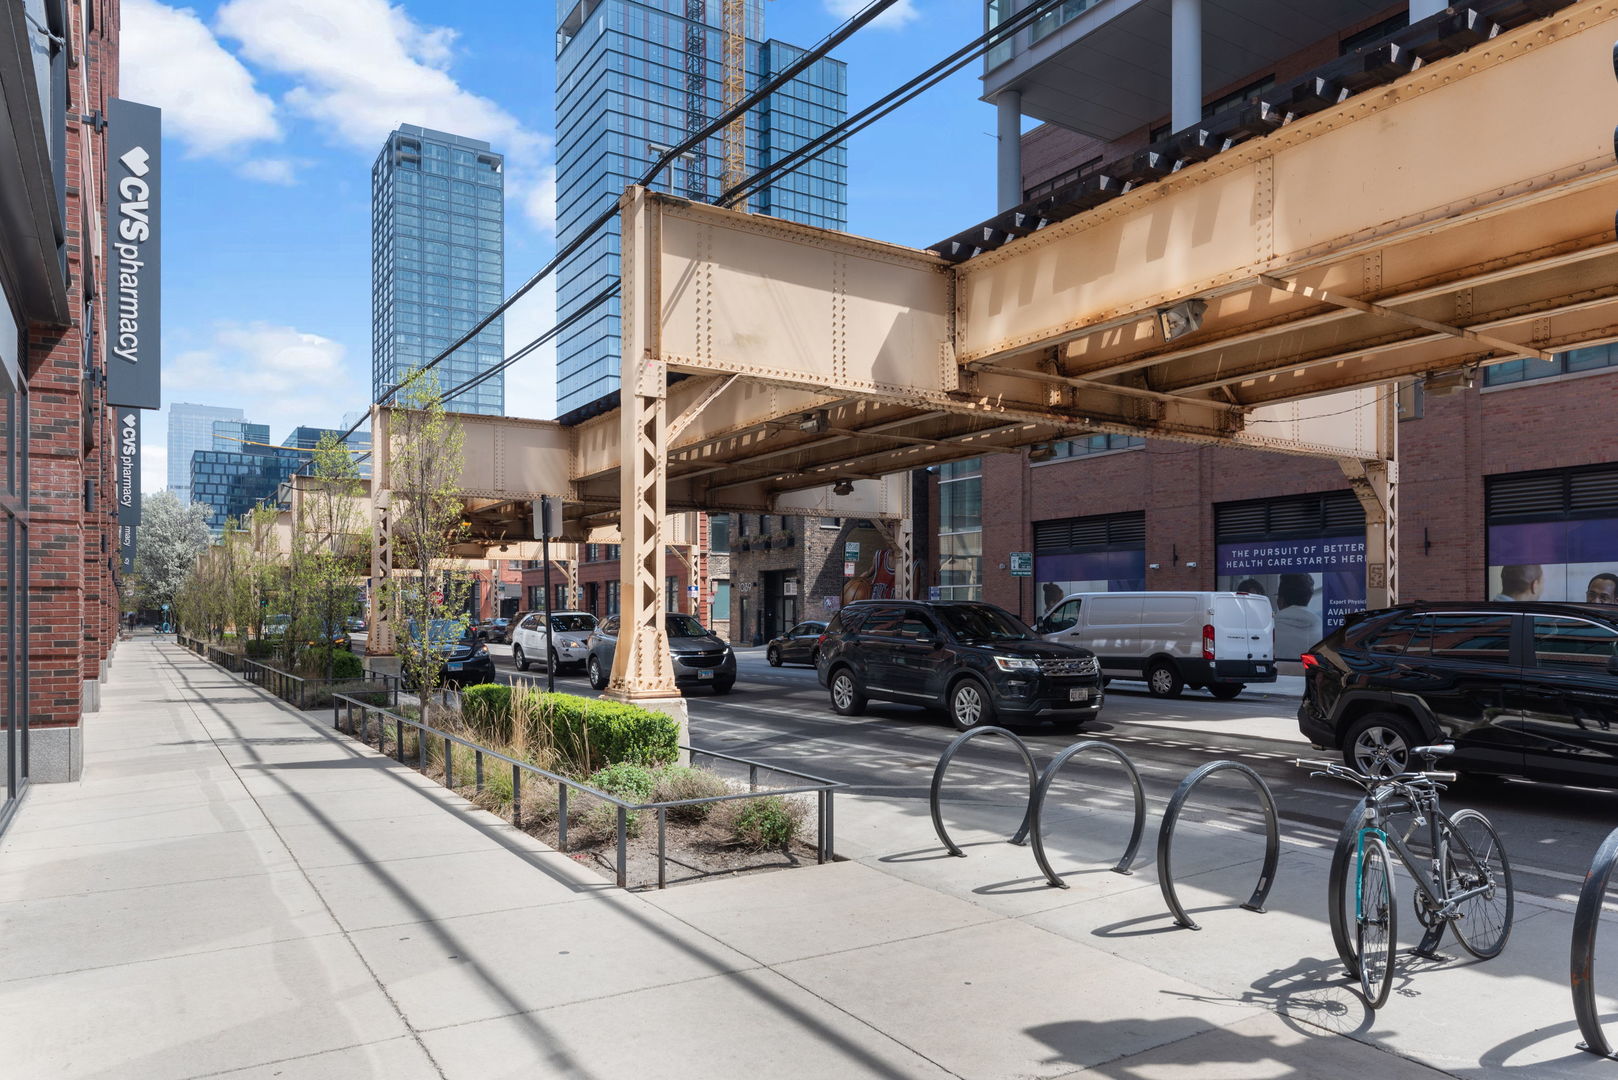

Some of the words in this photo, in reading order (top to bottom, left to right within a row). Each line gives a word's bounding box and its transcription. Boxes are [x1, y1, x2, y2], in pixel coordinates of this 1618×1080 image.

[120, 177, 149, 242] CVS
[114, 243, 144, 362] pharmacy
[122, 427, 136, 456] CVS
[121, 456, 134, 508] pharmacy
[1226, 560, 1263, 568] HEALTH
[1267, 558, 1293, 566] CARE
[1296, 556, 1337, 565] STARTS
[1232, 550, 1249, 558] THE
[1253, 546, 1298, 556] PURSUIT
[1303, 546, 1317, 554] OF
[1323, 543, 1365, 553] BETTER
